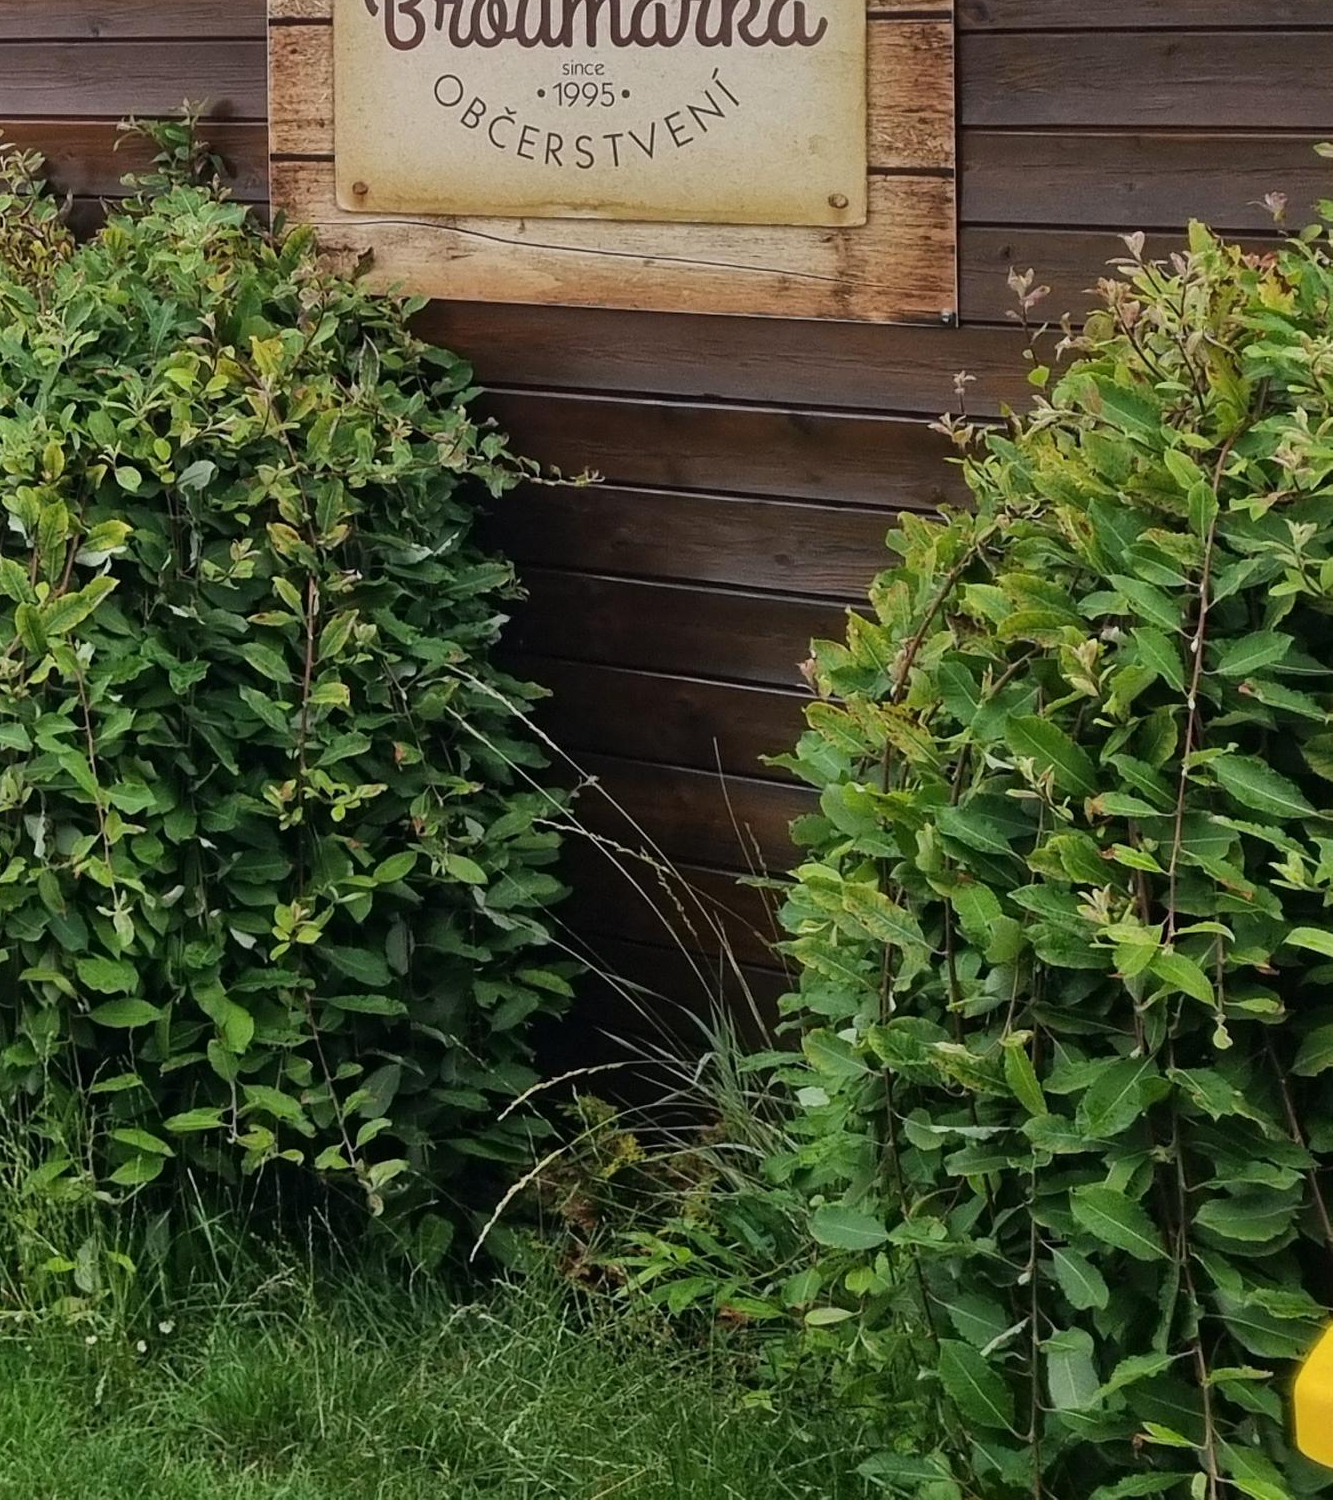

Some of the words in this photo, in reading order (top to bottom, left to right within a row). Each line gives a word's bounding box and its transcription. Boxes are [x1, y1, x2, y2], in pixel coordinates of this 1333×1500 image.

[561, 60, 606, 77] since
[552, 82, 616, 108] 1995
[434, 68, 740, 170] OBČERSTVENÍ
